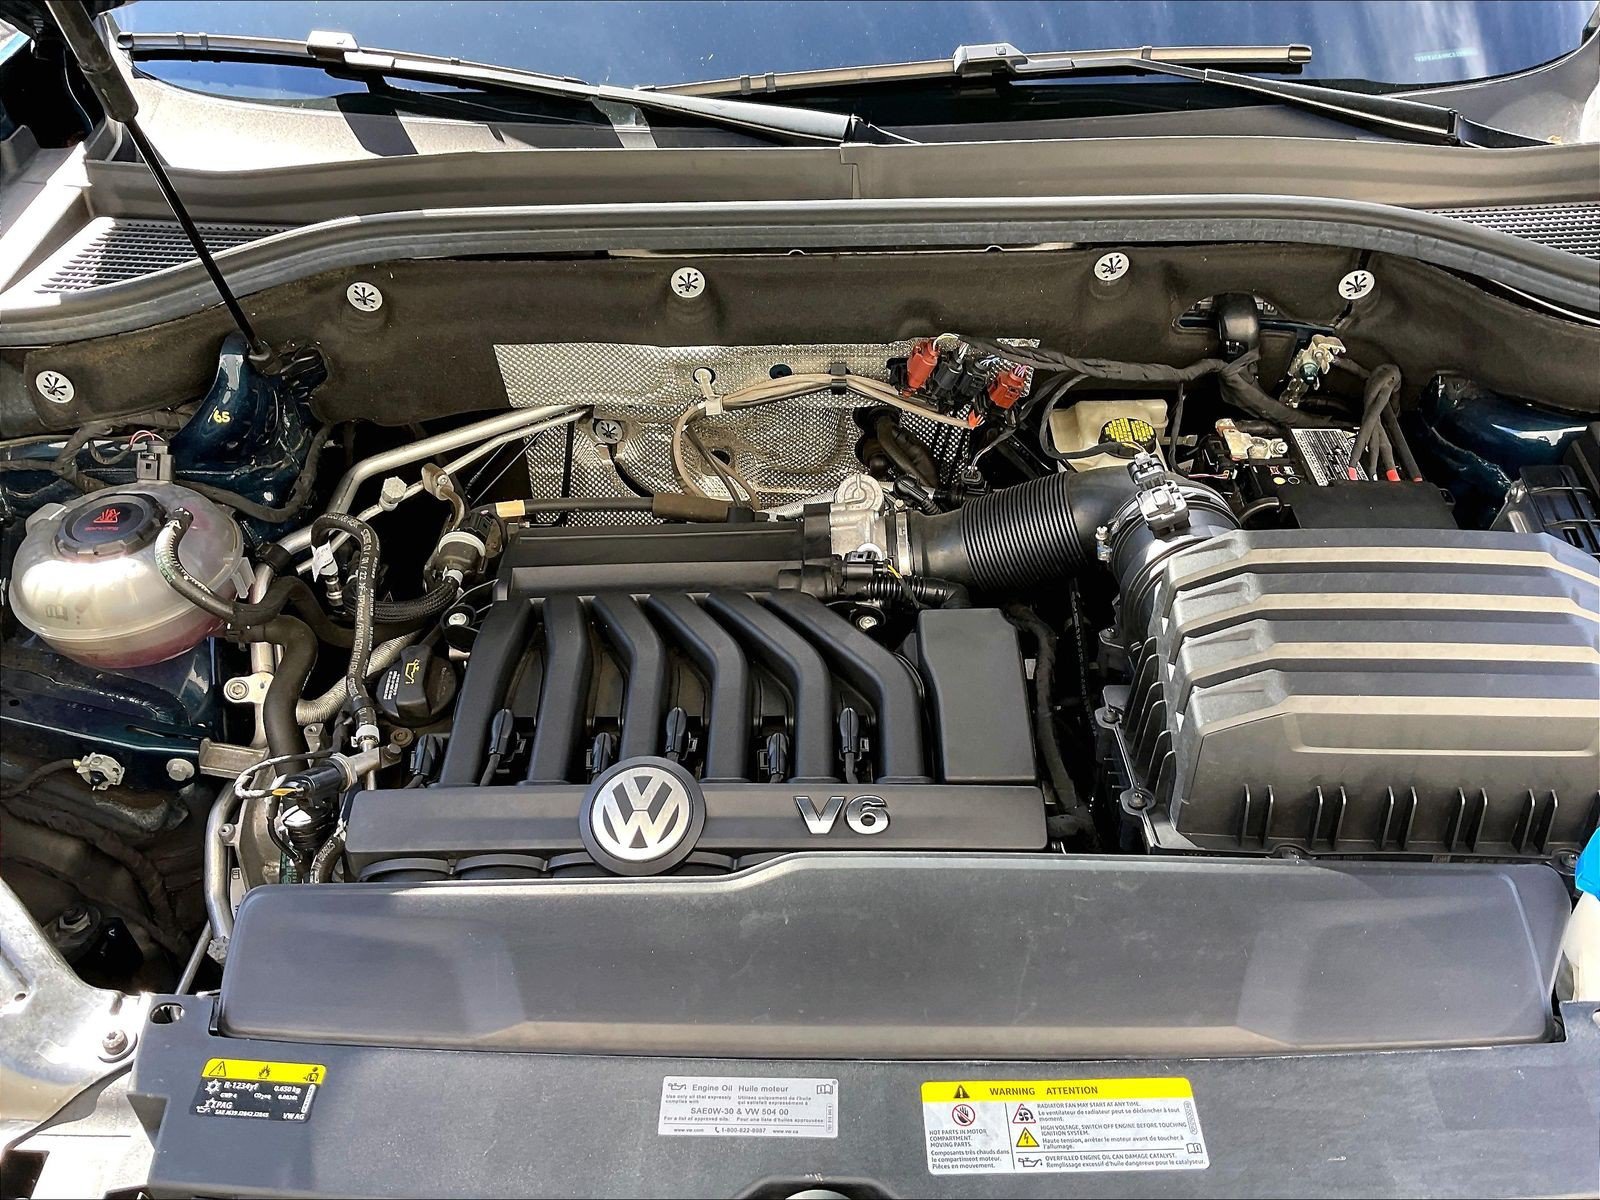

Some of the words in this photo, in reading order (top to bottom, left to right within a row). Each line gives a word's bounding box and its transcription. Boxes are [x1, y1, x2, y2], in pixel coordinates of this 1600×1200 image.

[793, 795, 890, 835] V6
[223, 1082, 259, 1092] R-1234yf
[292, 1086, 301, 1094] kg
[692, 1084, 719, 1092] Engine
[721, 1084, 733, 1092] Oil
[989, 1087, 1036, 1096] WARNING
[1046, 1086, 1099, 1095] ATTENTION
[216, 1101, 233, 1109] PAG
[690, 1107, 734, 1115] SAE0W-30
[938, 1156, 980, 1164] compartiment
